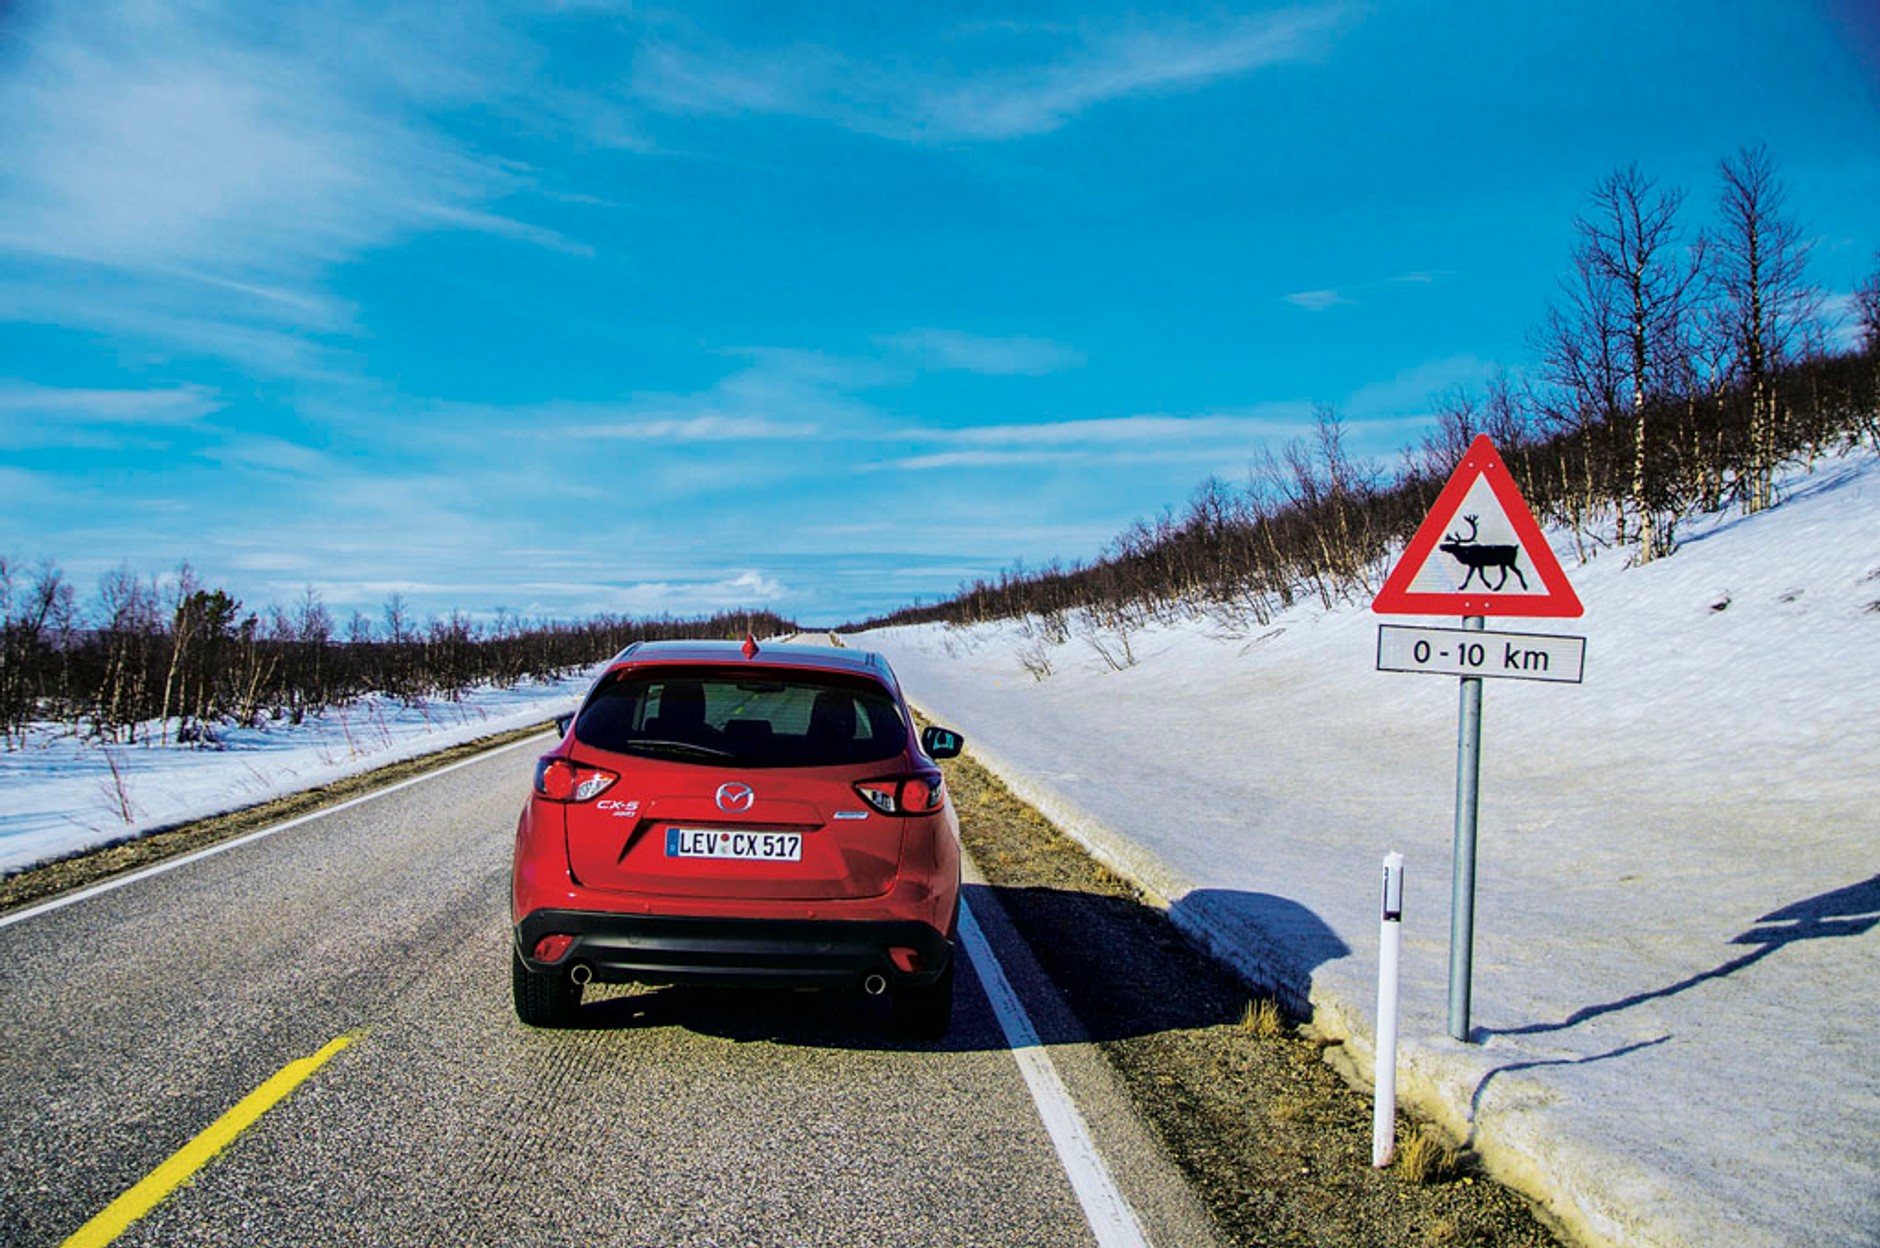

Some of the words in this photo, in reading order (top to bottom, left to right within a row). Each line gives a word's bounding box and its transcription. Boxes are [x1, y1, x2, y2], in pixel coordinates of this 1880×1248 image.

[1504, 642, 1549, 671] km
[680, 832, 718, 854] LEV
[732, 833, 758, 856] CX
[763, 835, 800, 858] 517
